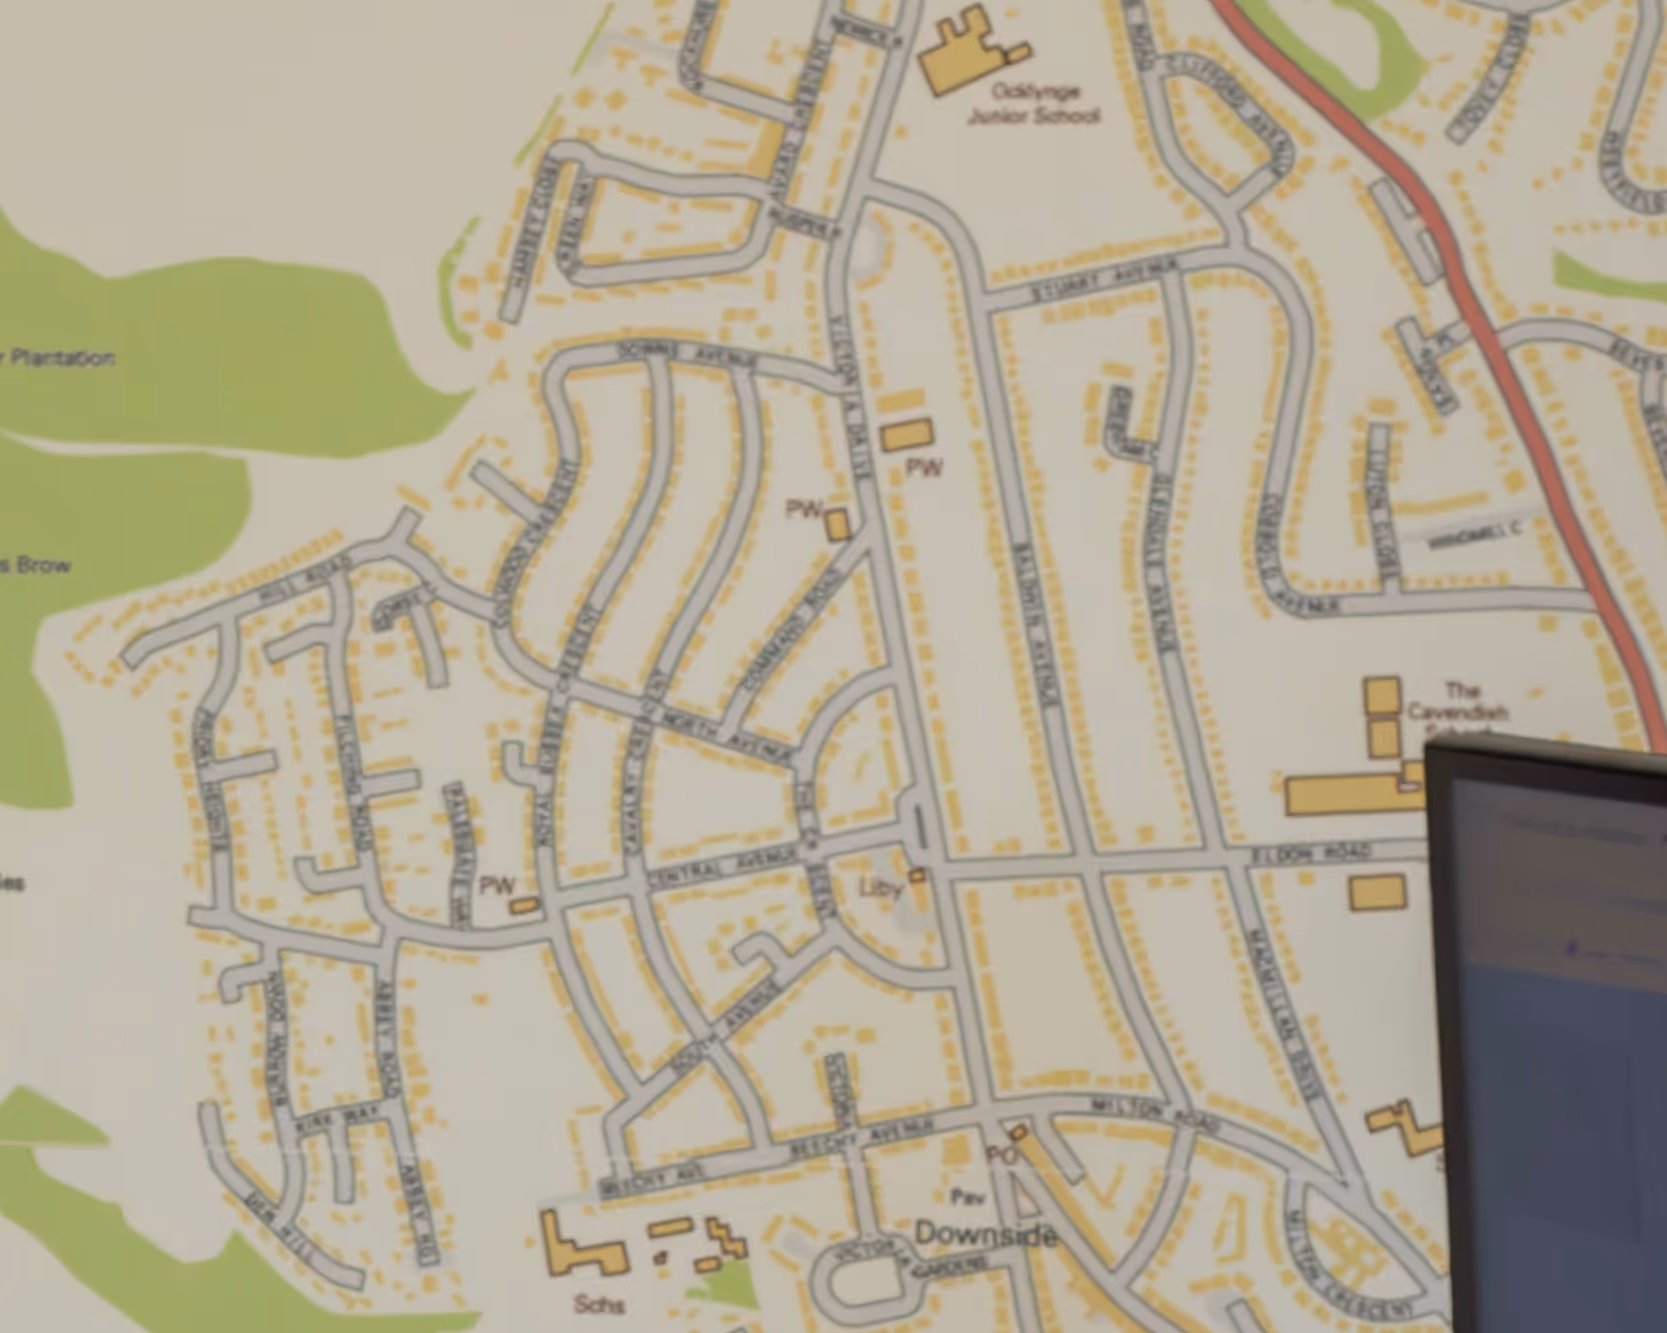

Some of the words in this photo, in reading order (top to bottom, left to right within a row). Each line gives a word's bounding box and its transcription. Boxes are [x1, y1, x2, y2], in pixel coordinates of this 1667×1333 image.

[992, 82, 1081, 102] Ocklynge
[967, 107, 1027, 125] Junior
[1033, 108, 1102, 125] School
[11, 348, 116, 369] Plantation
[906, 458, 944, 479] PW
[785, 499, 824, 520] PW
[17, 556, 73, 576] Brow
[1446, 681, 1481, 699] The
[1408, 703, 1509, 722] Cavendish
[479, 876, 516, 895] PW
[858, 877, 906, 901] Liby
[987, 1145, 1019, 1166] PO
[951, 1188, 986, 1207] Pav
[915, 1219, 1059, 1249] Downside
[574, 1294, 626, 1315] Schs
